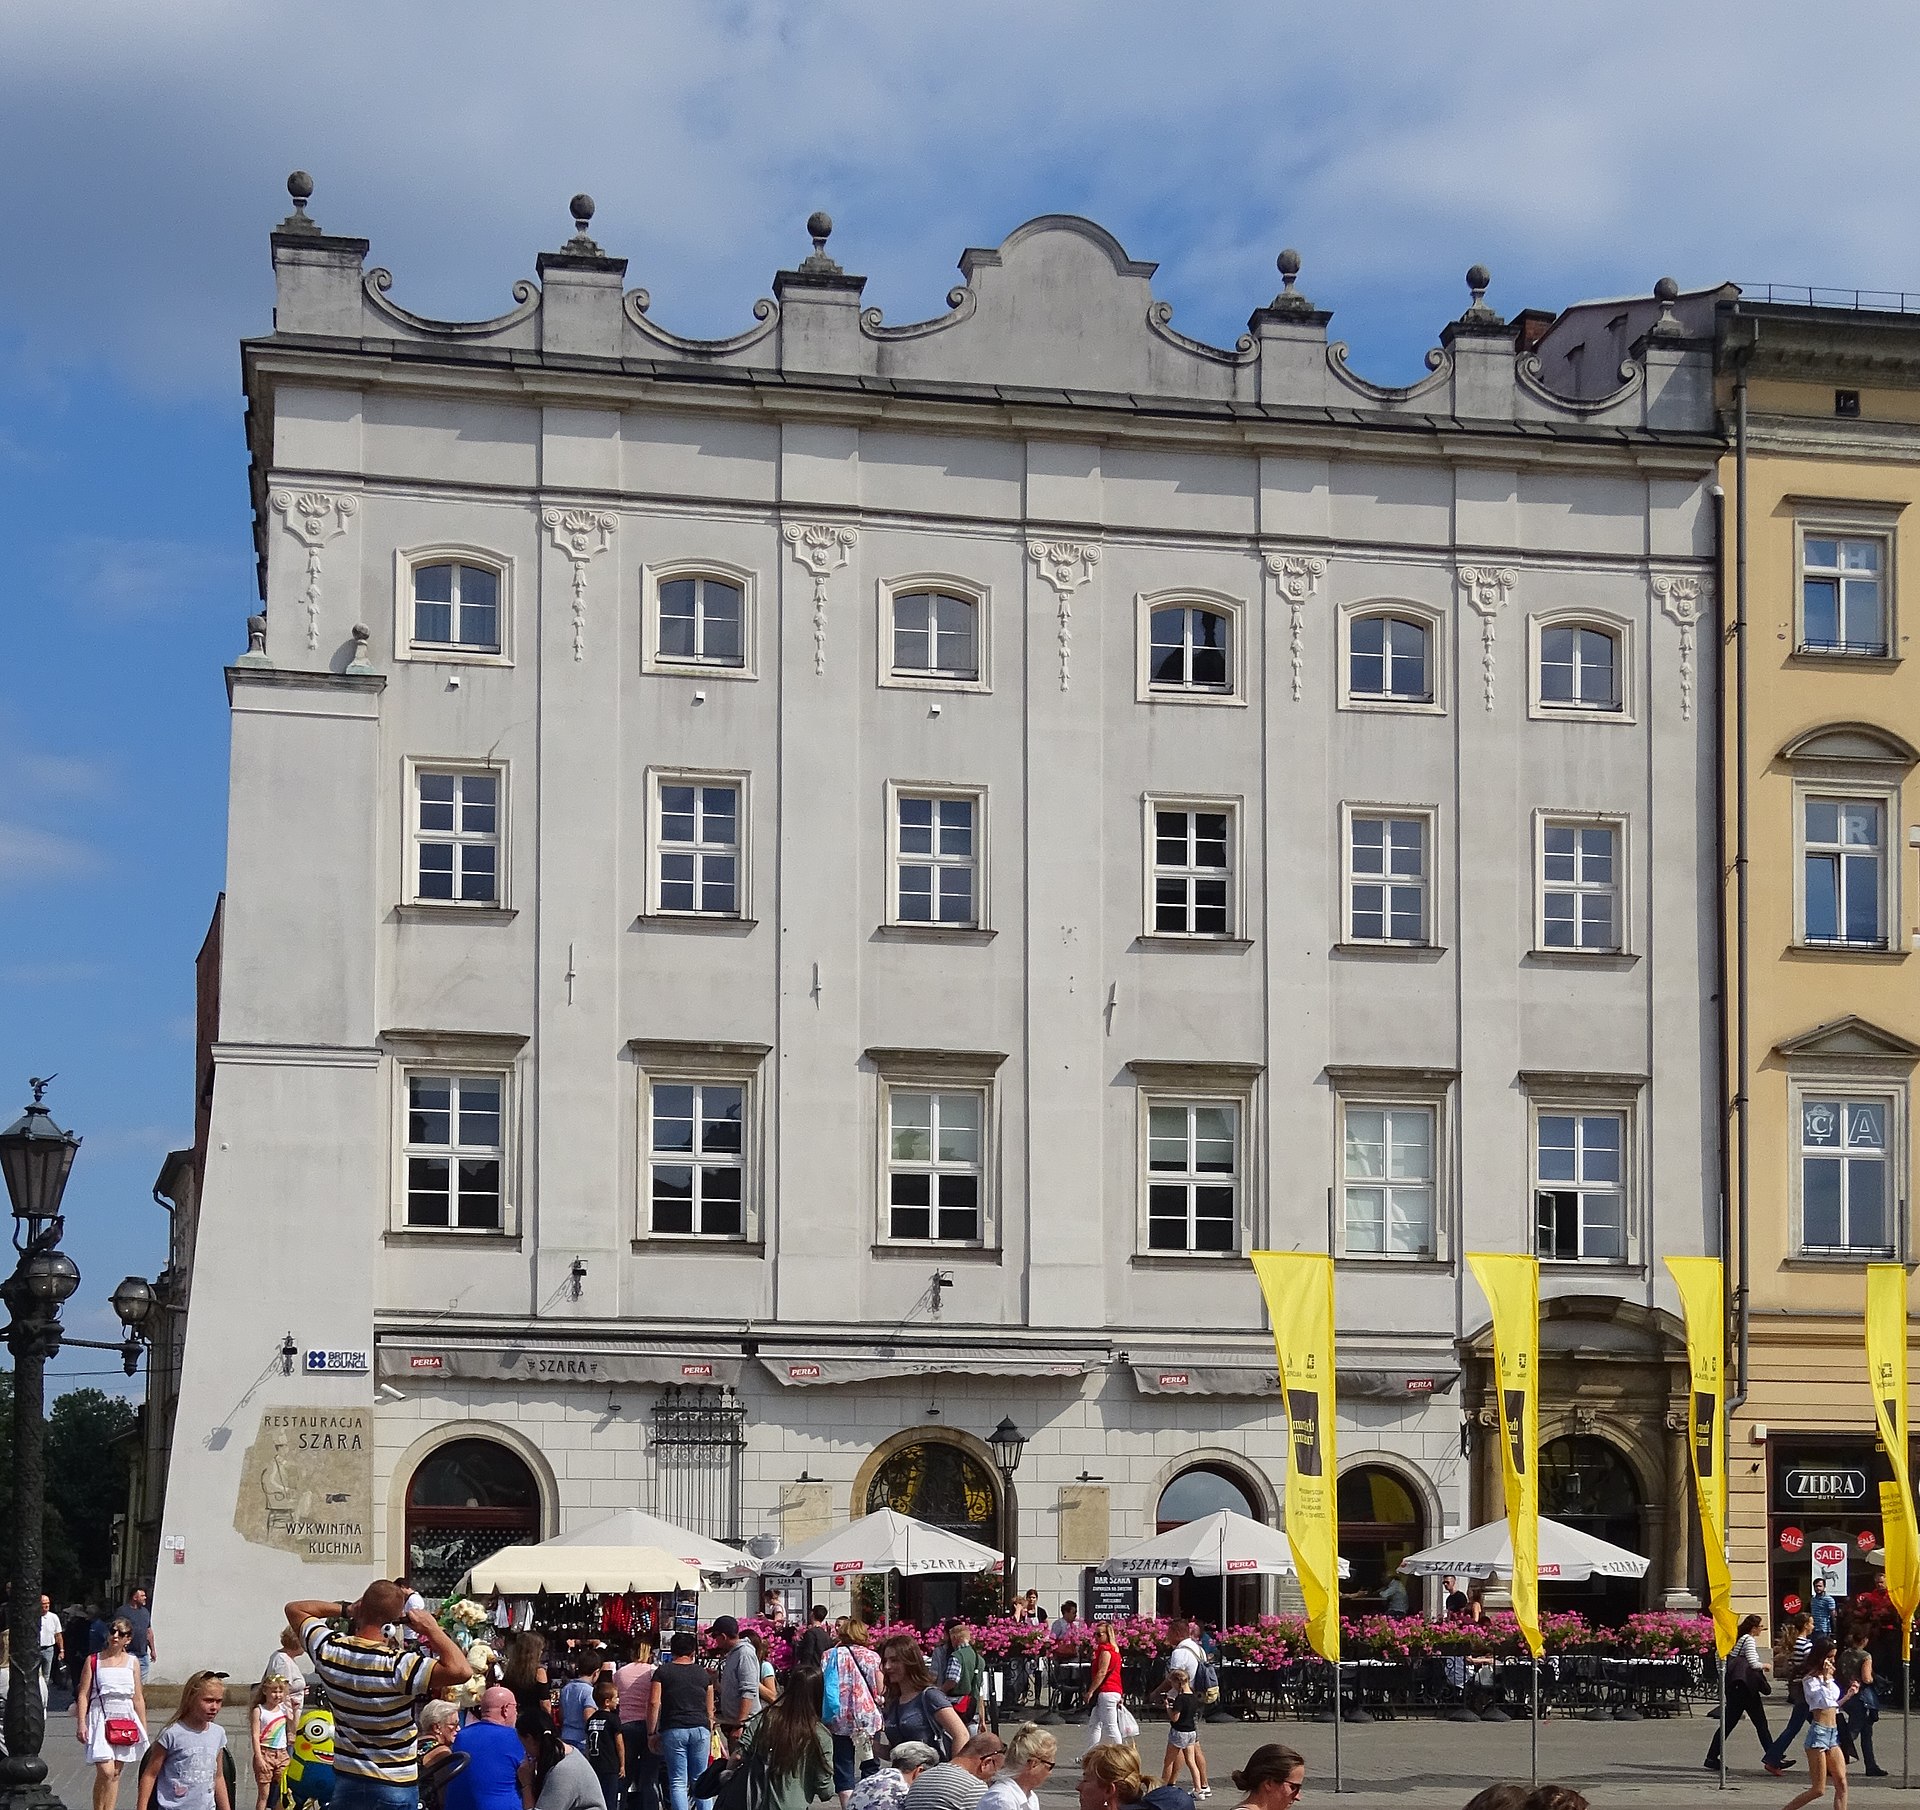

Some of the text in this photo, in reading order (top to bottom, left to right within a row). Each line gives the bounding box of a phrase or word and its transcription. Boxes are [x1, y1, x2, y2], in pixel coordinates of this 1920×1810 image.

[1846, 815, 1869, 844] R
[1812, 1116, 1827, 1134] C
[1849, 1109, 1882, 1143] A
[328, 1351, 365, 1361] BRITISH
[413, 1357, 441, 1367] PERŁA
[328, 1360, 368, 1369] COUNCIL
[539, 1360, 586, 1374] SZARA
[684, 1365, 710, 1375] PERŁA
[791, 1367, 817, 1377] PERŁA
[1161, 1375, 1186, 1385] PERŁA
[1408, 1380, 1433, 1390] PERŁA
[264, 1416, 363, 1429] RESTAURACJA
[299, 1433, 363, 1450] SZARA
[1797, 1475, 1855, 1494] ZEBRA
[286, 1522, 362, 1536] WYKWINTNA
[1780, 1533, 1804, 1547] SALE
[1857, 1535, 1876, 1548] SALE
[309, 1542, 362, 1555] KUCHNIA
[1816, 1549, 1843, 1560] SALE!
[835, 1562, 861, 1571] PERŁA
[921, 1560, 966, 1570] SZARA
[1130, 1559, 1168, 1571] SZARA
[1229, 1560, 1256, 1570] PERŁA
[1432, 1562, 1471, 1572] SZARA
[1538, 1566, 1558, 1574] ERŁA
[1609, 1561, 1639, 1573] SZARA
[1094, 1576, 1108, 1584] BAR
[1783, 1598, 1801, 1611] SALE
[590, 1731, 599, 1756] 1
